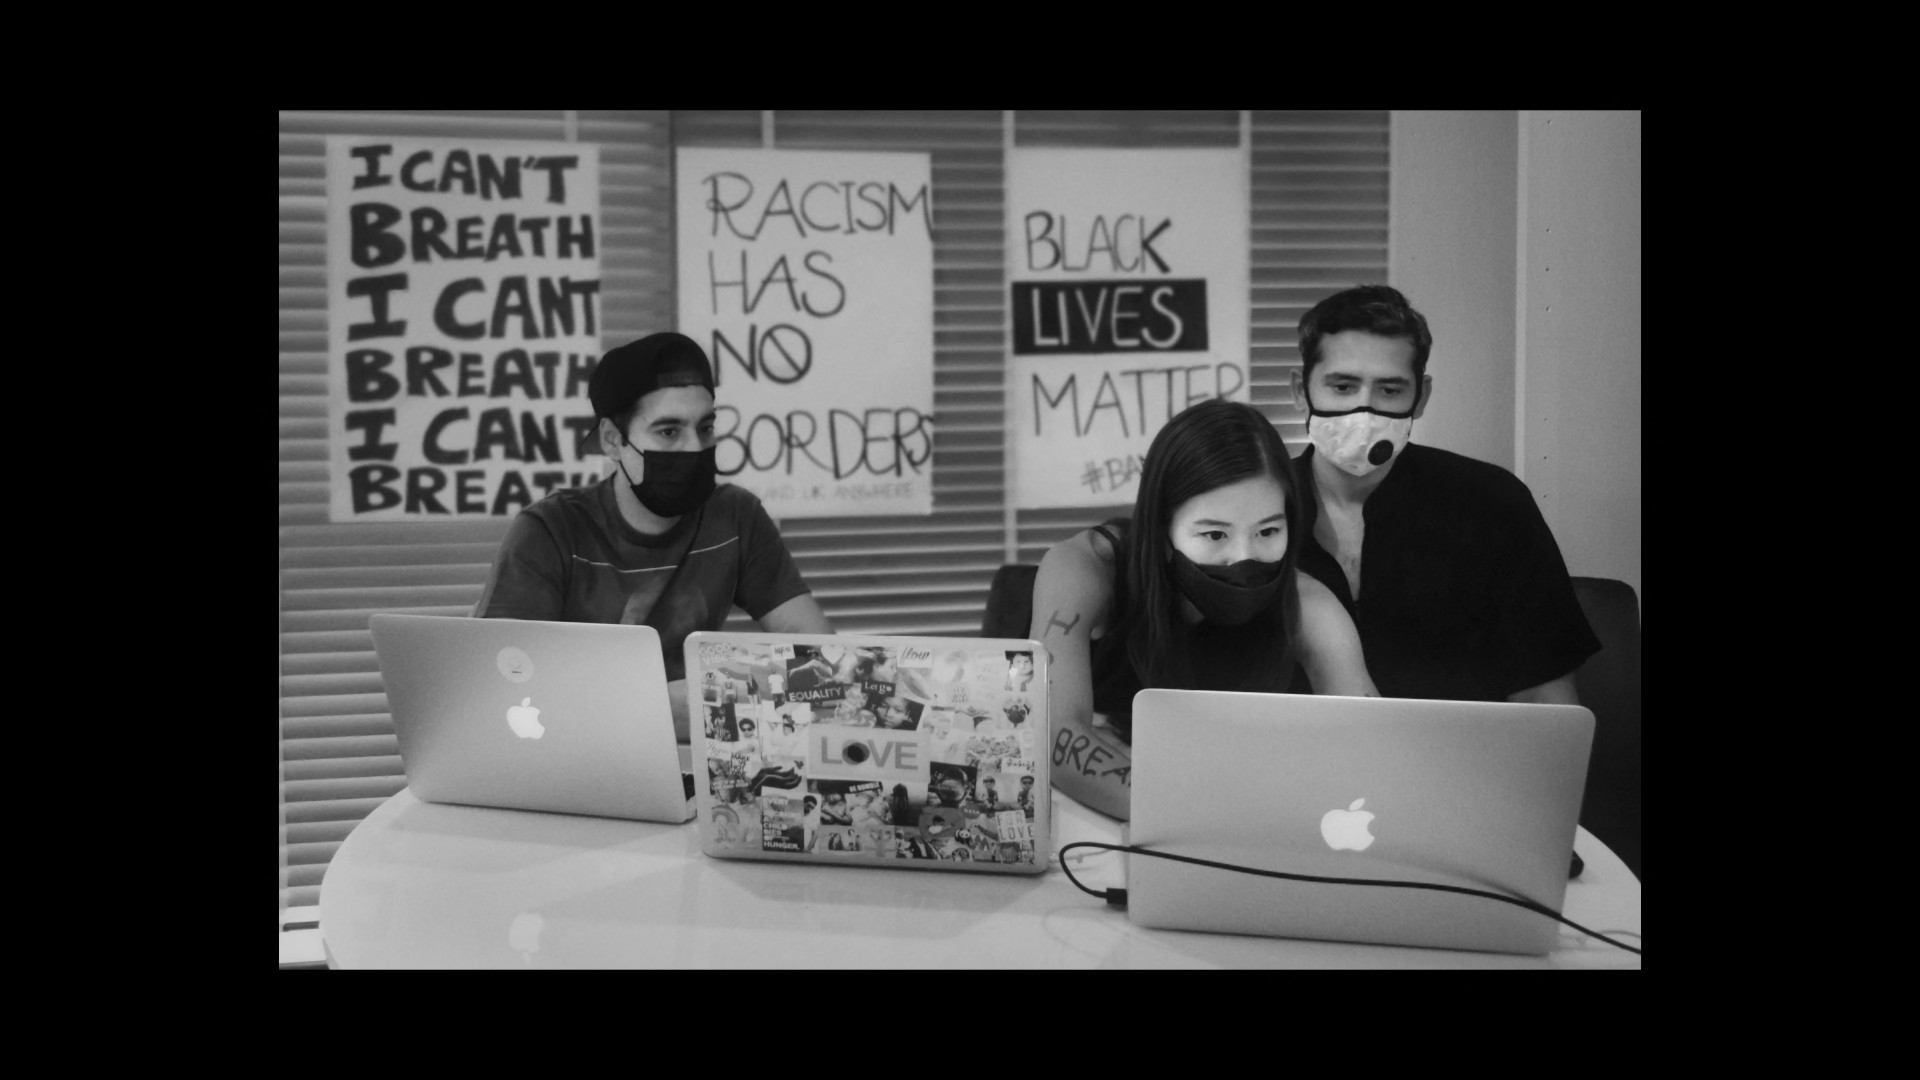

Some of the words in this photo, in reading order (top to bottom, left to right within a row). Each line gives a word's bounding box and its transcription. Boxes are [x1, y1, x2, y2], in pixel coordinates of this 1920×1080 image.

[350, 144, 392, 190] I
[400, 149, 579, 204] CAN'T
[350, 202, 595, 268] BREATH
[702, 171, 934, 241] RACISM
[1025, 210, 1171, 274] BLACK
[346, 272, 408, 342] I
[433, 275, 600, 339] CANT
[708, 249, 846, 318] HAS
[1032, 286, 1183, 348] LIVES
[345, 346, 599, 403] BREATH
[712, 324, 813, 387] NO
[345, 407, 398, 461] I
[714, 405, 934, 481] BORDERS
[1081, 454, 1147, 494] #BA
[788, 686, 842, 702] EQUALITY
[821, 736, 919, 770] LOVE
[1052, 727, 1131, 787] BREA
